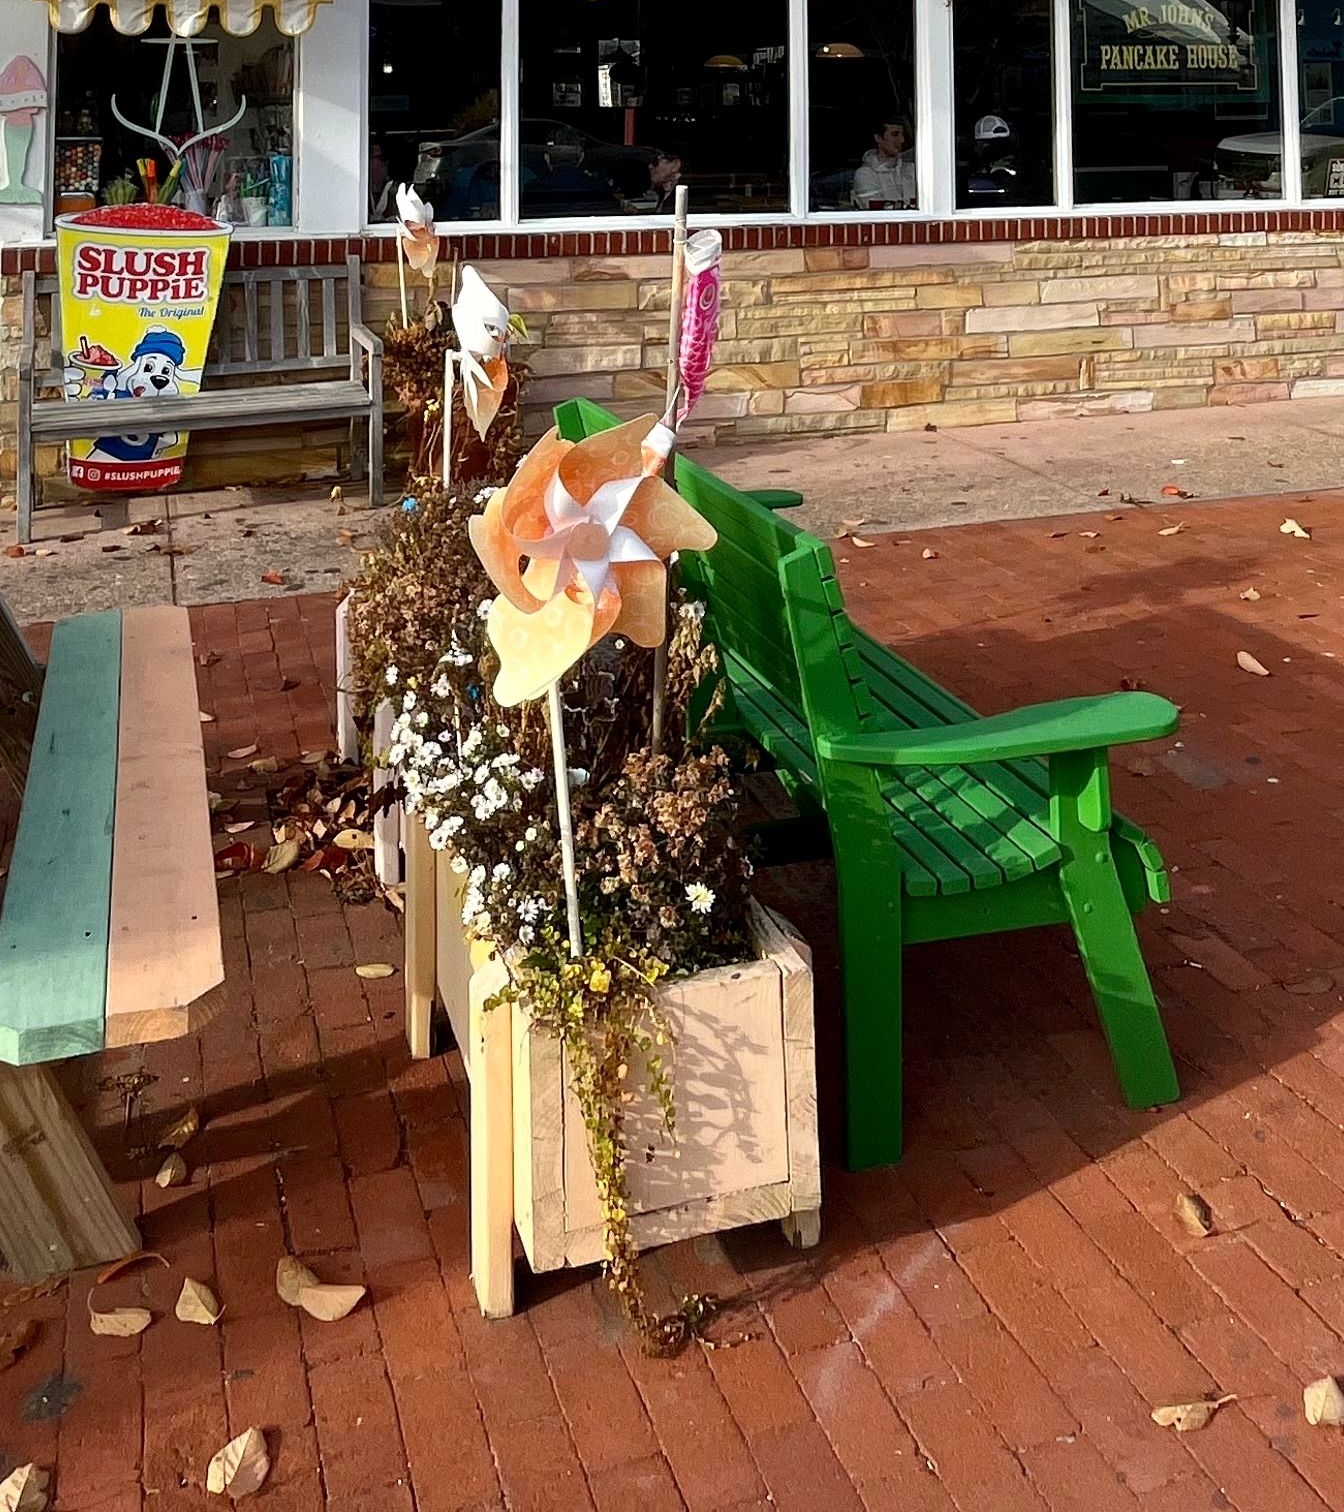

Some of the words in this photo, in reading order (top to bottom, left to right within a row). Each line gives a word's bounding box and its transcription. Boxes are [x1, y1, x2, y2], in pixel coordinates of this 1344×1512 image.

[1100, 44, 1179, 70] PANCAKE
[1186, 44, 1238, 69] HOUSE
[78, 246, 207, 277] SLUSH
[139, 306, 157, 319] The
[160, 306, 205, 321] Original
